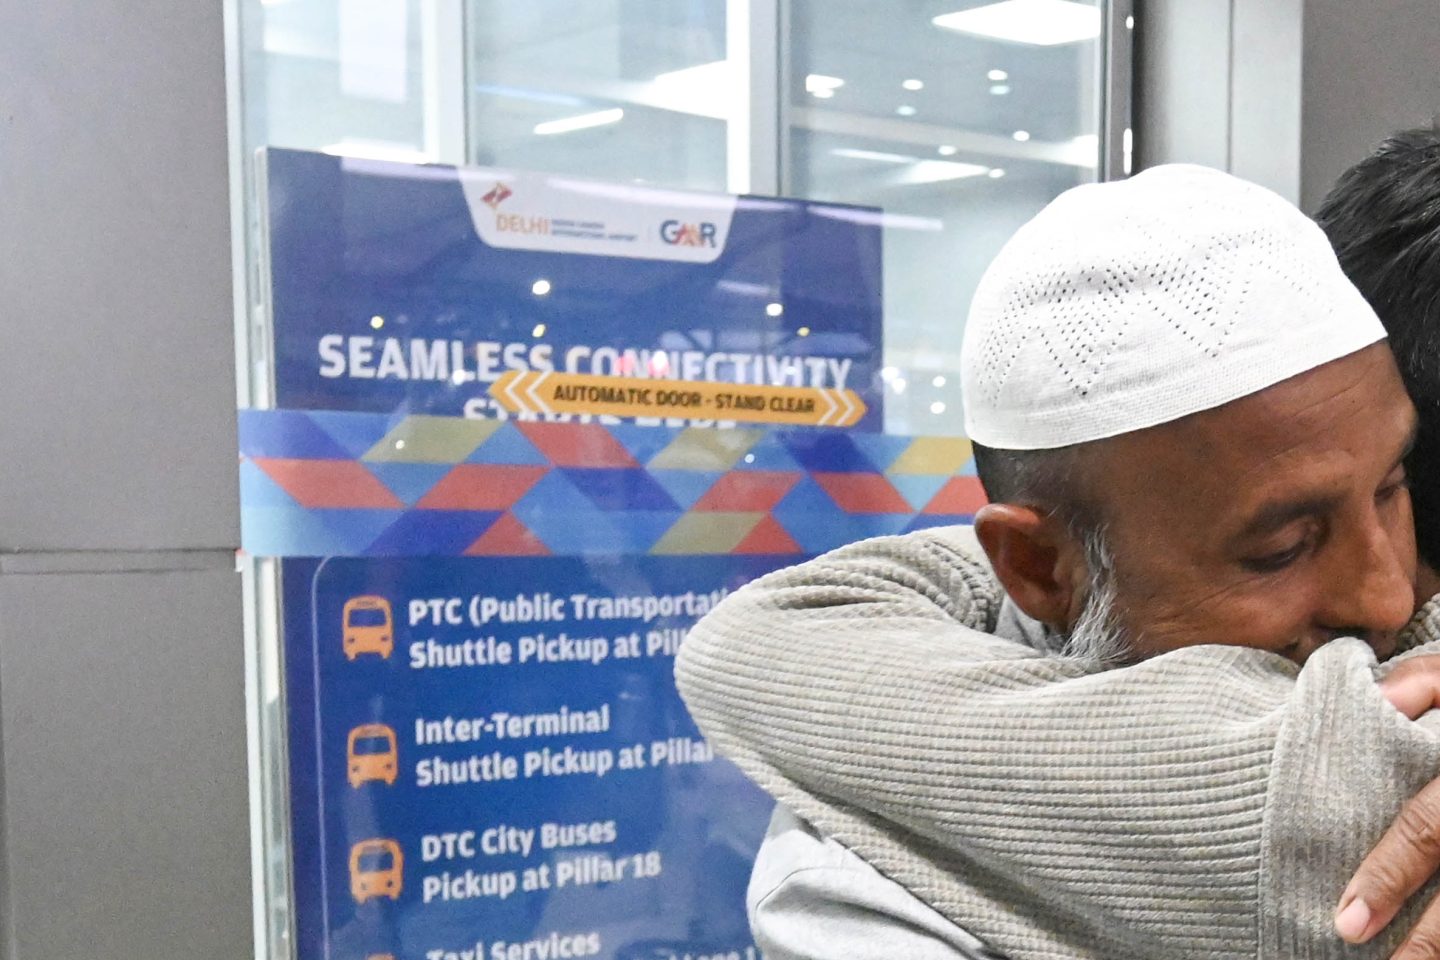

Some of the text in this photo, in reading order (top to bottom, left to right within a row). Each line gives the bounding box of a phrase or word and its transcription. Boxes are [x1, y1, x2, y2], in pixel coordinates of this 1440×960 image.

[496, 214, 550, 235] DELHI
[318, 334, 852, 391] SEAMLESS CONNECTIVITY
[553, 384, 652, 406] AUTOMATIC
[656, 389, 703, 408] DOOR
[716, 392, 765, 412] STAND
[769, 396, 816, 413] CLEAR
[409, 597, 462, 626] PTC
[469, 592, 565, 628] (Public
[409, 636, 512, 669] Shuttle
[518, 633, 609, 665] Pickup
[614, 631, 642, 659] at
[415, 703, 610, 745] Inter-Terminal
[415, 751, 518, 787] Shuttle
[524, 746, 613, 778] Pickup
[618, 744, 646, 770] at
[421, 819, 617, 862] DTC City Buses
[422, 850, 662, 904] Pickup at Pillar 18
